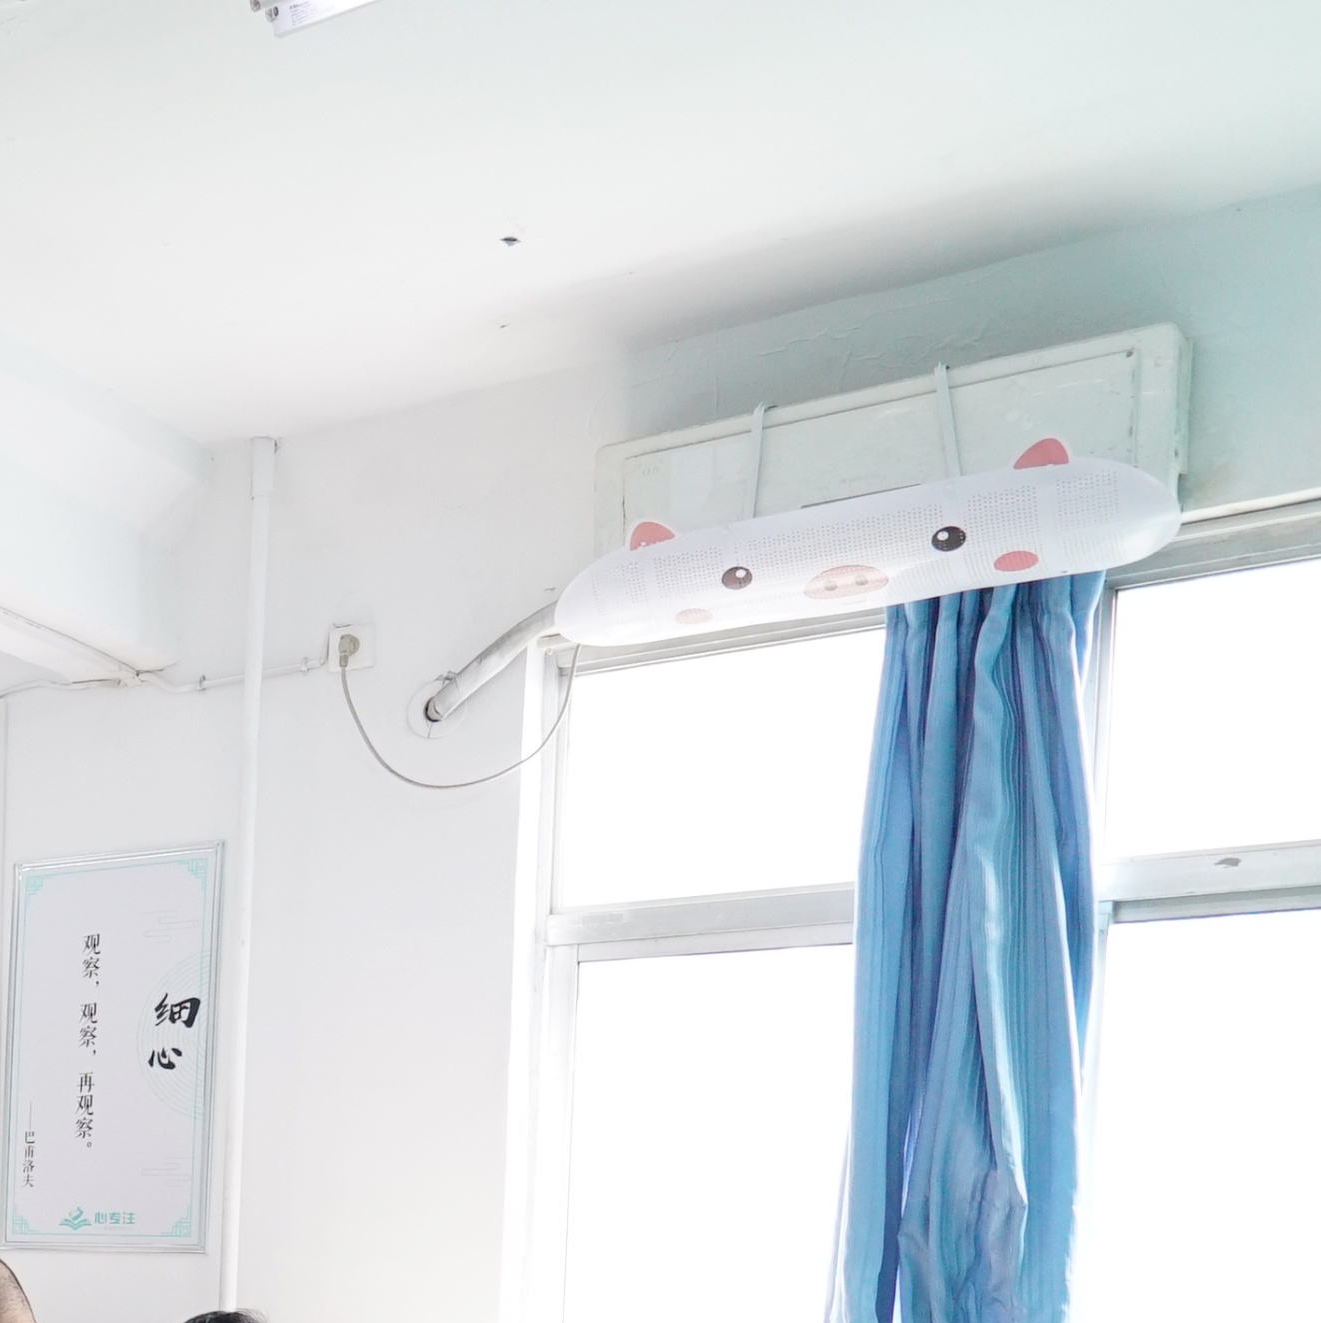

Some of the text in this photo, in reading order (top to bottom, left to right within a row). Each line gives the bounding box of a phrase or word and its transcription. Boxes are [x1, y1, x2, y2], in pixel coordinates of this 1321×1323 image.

[147, 991, 201, 1071] 细心
[94, 1211, 136, 1225] 心专注
